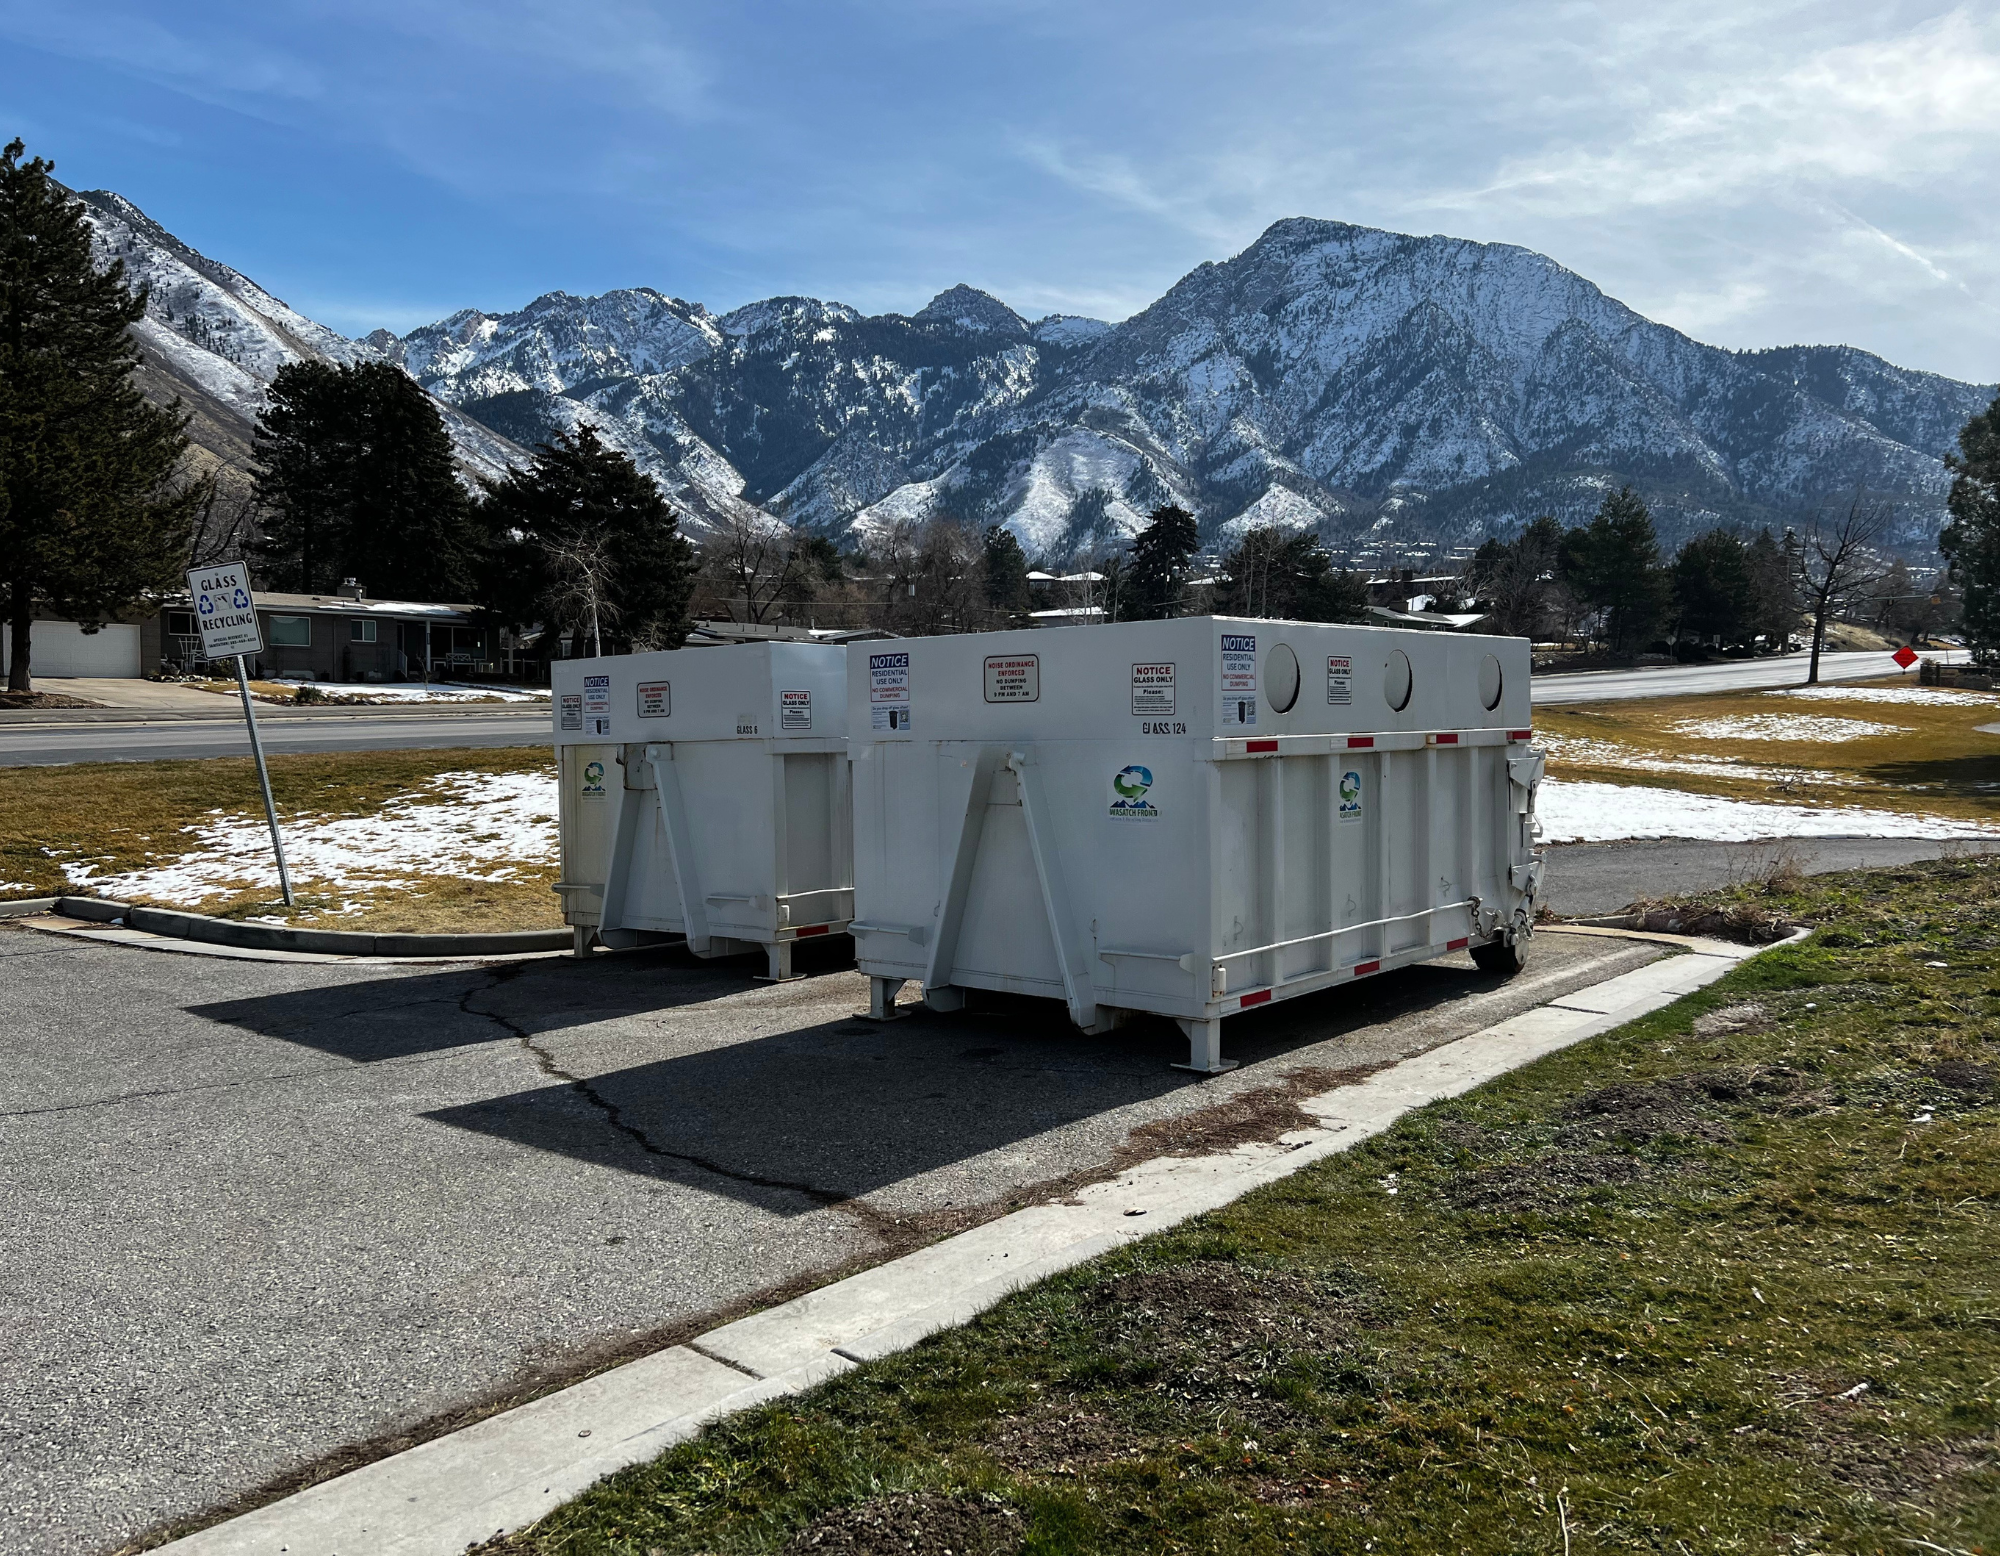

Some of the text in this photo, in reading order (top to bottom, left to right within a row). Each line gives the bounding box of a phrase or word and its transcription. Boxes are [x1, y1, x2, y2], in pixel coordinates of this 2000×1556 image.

[201, 575, 237, 591] GLASS
[202, 613, 252, 630] RECYCLING
[1222, 637, 1255, 650] NOTICE
[871, 655, 907, 668] NOTICE
[1223, 653, 1254, 661] RESIDENTIAL
[1330, 659, 1349, 667] NOTICE
[872, 669, 907, 677] RESIDENTIAL
[998, 669, 1025, 677] ENFORCED
[1136, 666, 1171, 675] NOTICE
[585, 677, 608, 686] NOTICE
[736, 725, 758, 734] GLASS 6
[1142, 722, 1187, 734] GLASS 124
[1109, 808, 1137, 816] WASATCH
